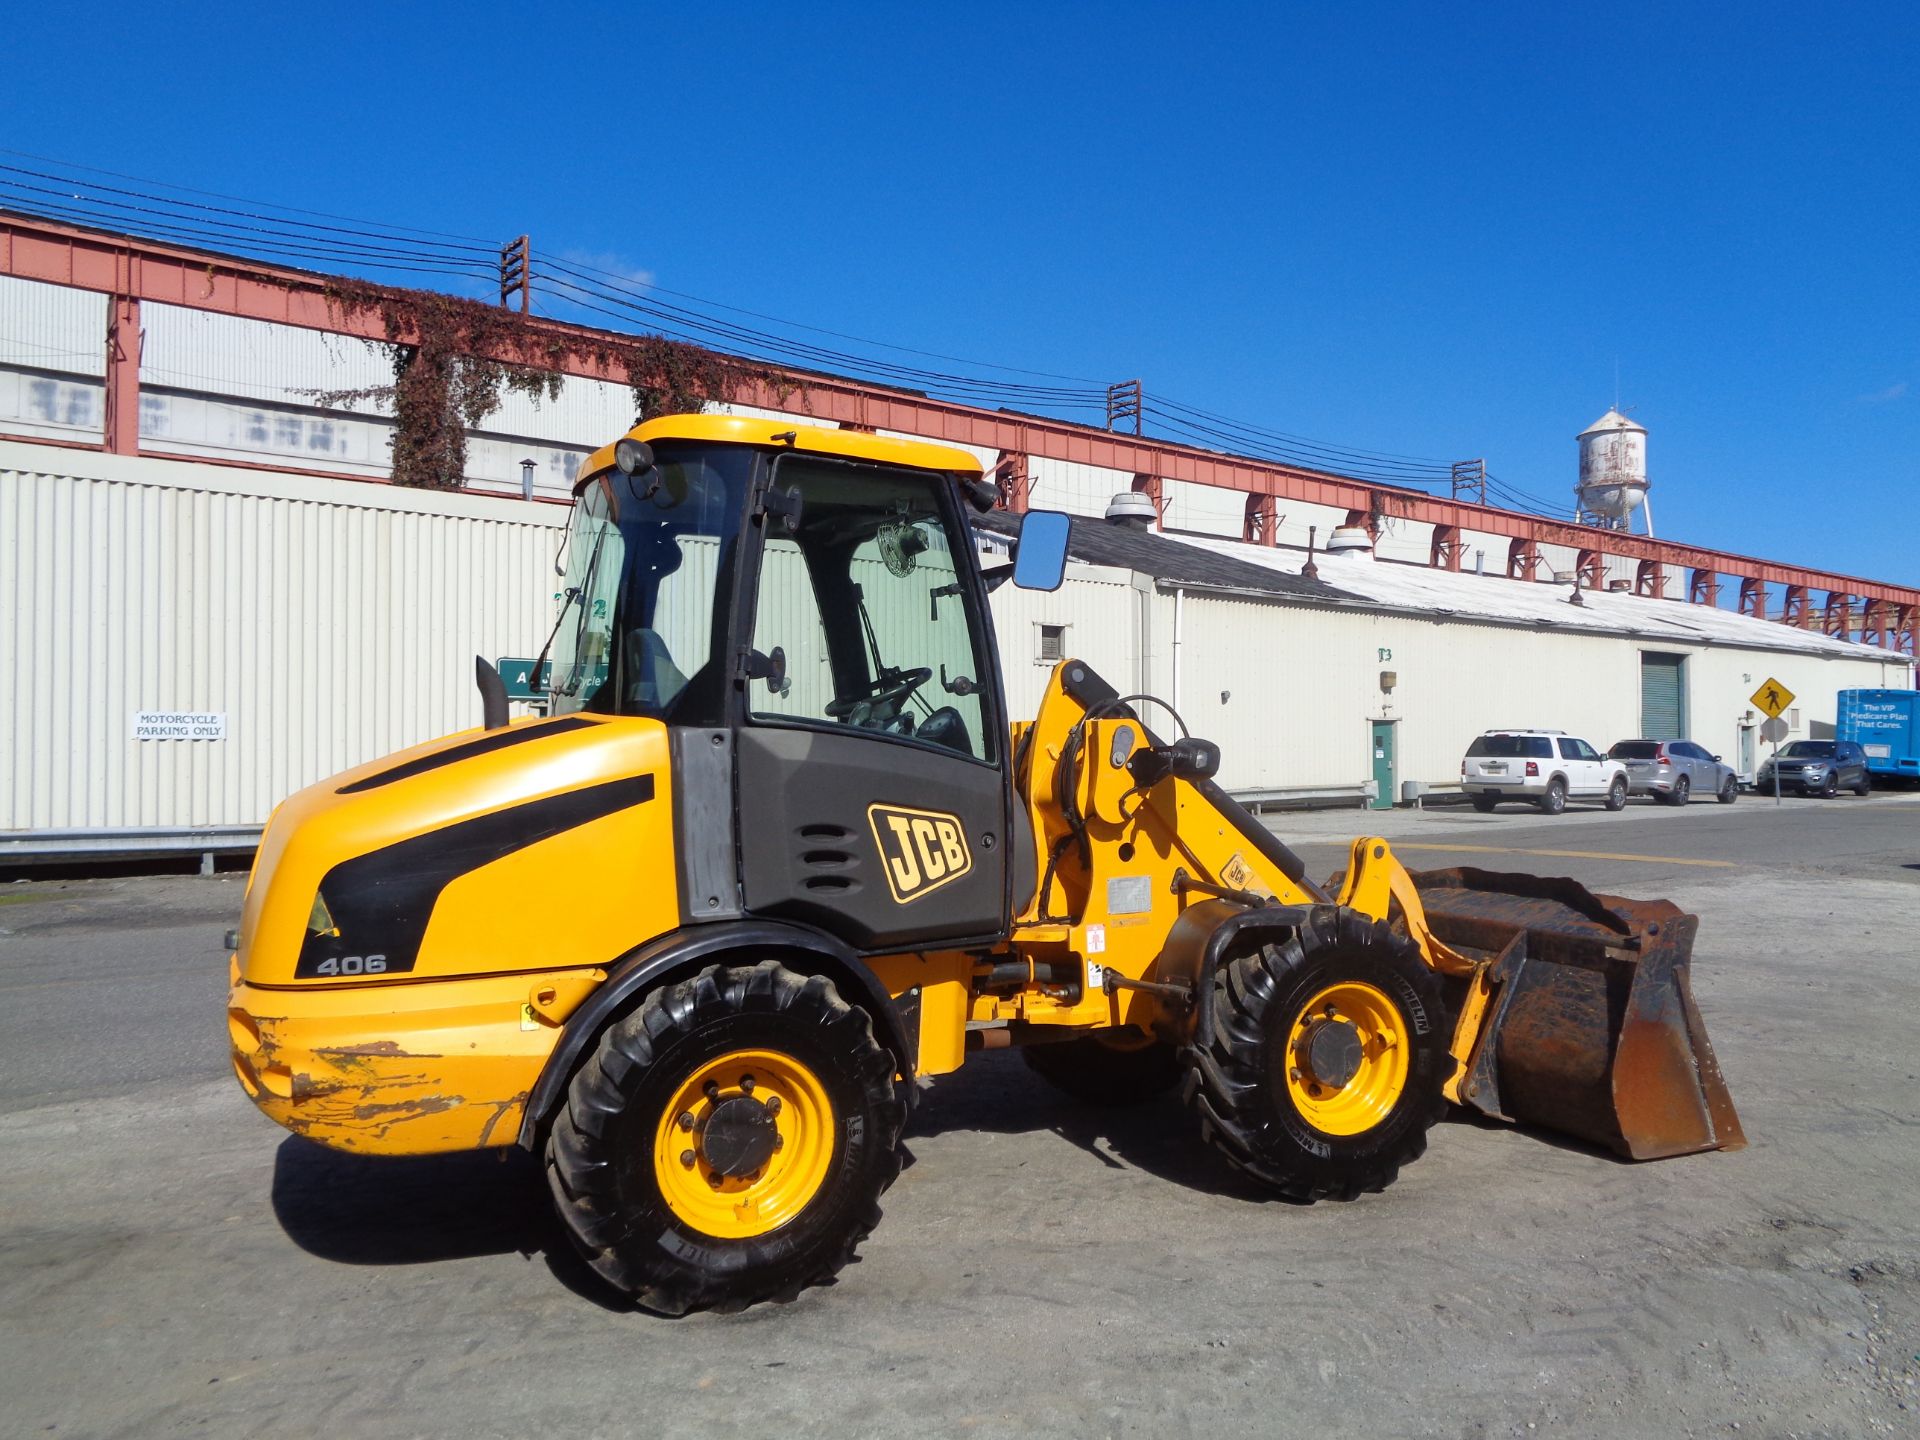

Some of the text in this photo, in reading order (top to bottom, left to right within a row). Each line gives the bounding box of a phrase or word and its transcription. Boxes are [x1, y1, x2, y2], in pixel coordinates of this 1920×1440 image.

[140, 715, 217, 724] MOTORCYCLE
[1850, 712, 1889, 720] Medicare
[136, 726, 222, 736] PARKING ONLY
[887, 815, 965, 892] JCB
[317, 954, 387, 976] 406
